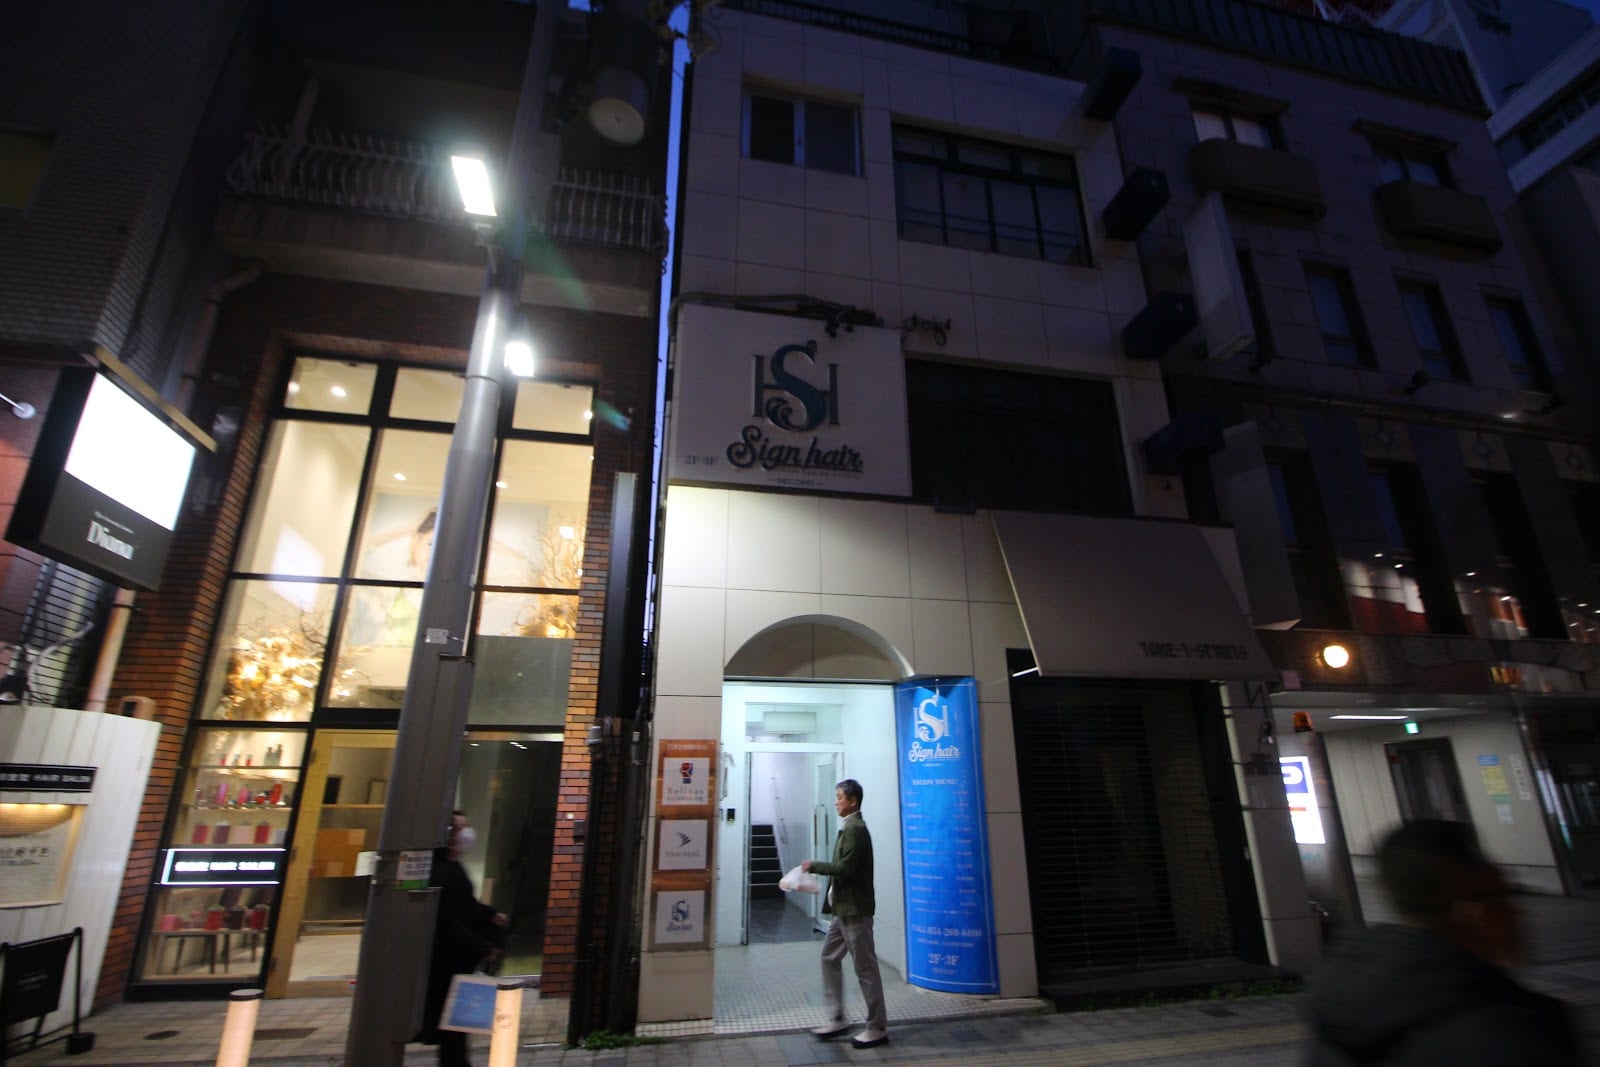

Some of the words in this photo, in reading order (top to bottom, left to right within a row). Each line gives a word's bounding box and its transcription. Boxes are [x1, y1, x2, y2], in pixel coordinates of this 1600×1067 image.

[726, 425, 801, 470] Sign
[804, 437, 864, 472] hair
[908, 741, 935, 762] Sign
[935, 742, 961, 759] hair
